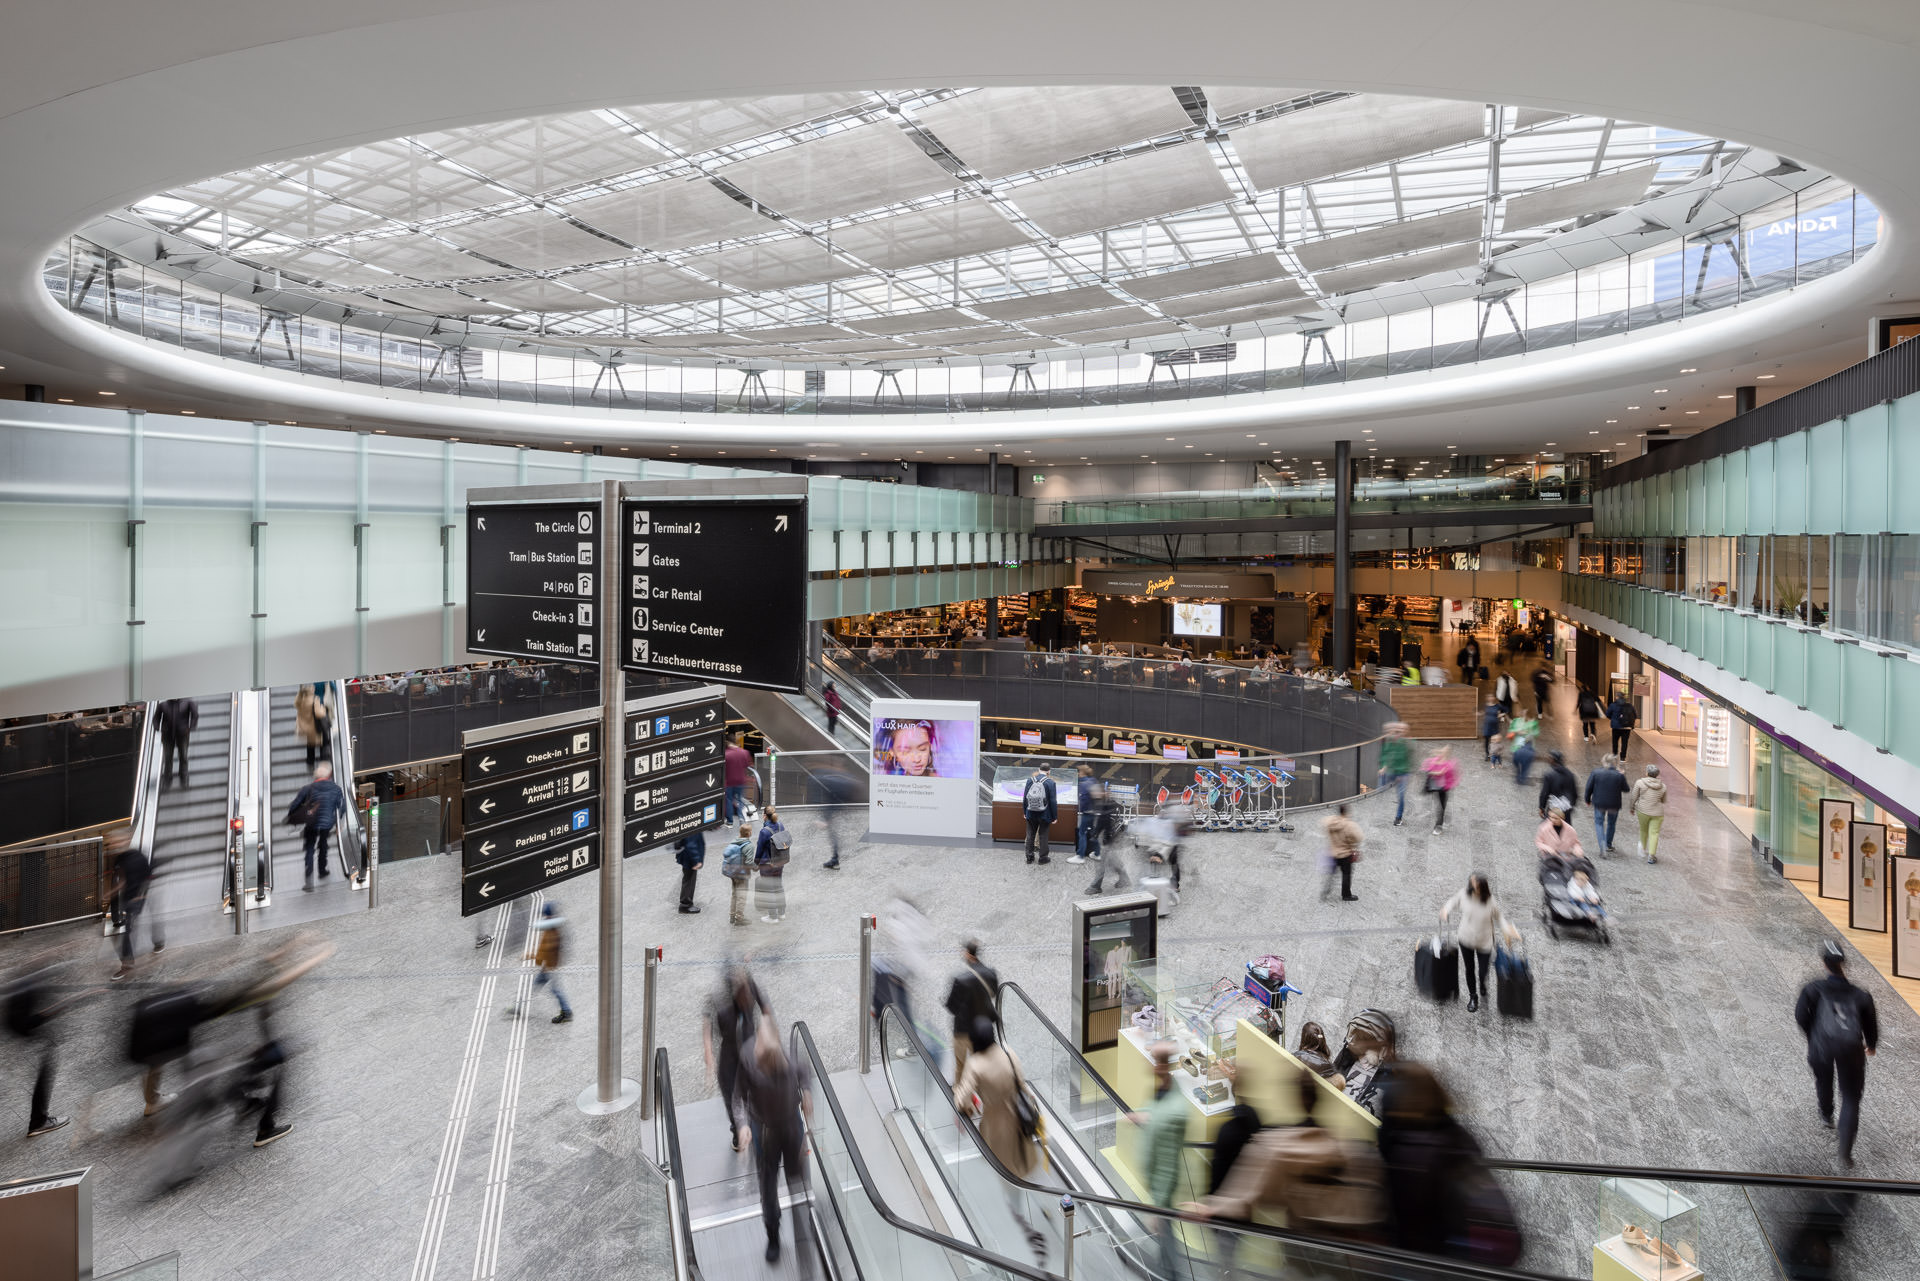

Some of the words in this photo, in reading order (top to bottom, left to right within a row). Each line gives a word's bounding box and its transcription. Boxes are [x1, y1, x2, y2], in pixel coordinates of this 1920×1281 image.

[1768, 219, 1818, 236] AMD
[535, 522, 551, 533] The
[552, 522, 575, 533] Circle
[653, 522, 692, 534] Terminal
[694, 523, 701, 534] 2
[547, 552, 575, 563] Station
[653, 555, 680, 567] Gates
[652, 588, 669, 600] Car
[671, 589, 702, 601] Rental
[532, 611, 566, 623] Check-in
[568, 614, 574, 623] 3
[652, 620, 687, 634] Service
[690, 624, 724, 637] Center
[526, 639, 544, 651] Train
[546, 640, 574, 654] Station
[652, 652, 742, 674] Zuschauerterrasse
[672, 721, 694, 732] Parking
[526, 750, 563, 764] Check-in
[564, 748, 569, 756] 1
[669, 745, 695, 757] Toiletten
[669, 755, 689, 766] Toilets
[522, 781, 555, 797] Ankunft
[652, 787, 669, 798] Bahn
[527, 790, 554, 804] Arrival
[652, 794, 668, 804] Train
[665, 810, 701, 828] Raucherzone
[653, 823, 680, 840] Smoking
[681, 818, 702, 832] Lounge
[515, 832, 547, 848] Parking
[544, 854, 569, 869] Polizei
[546, 864, 569, 877] Police
